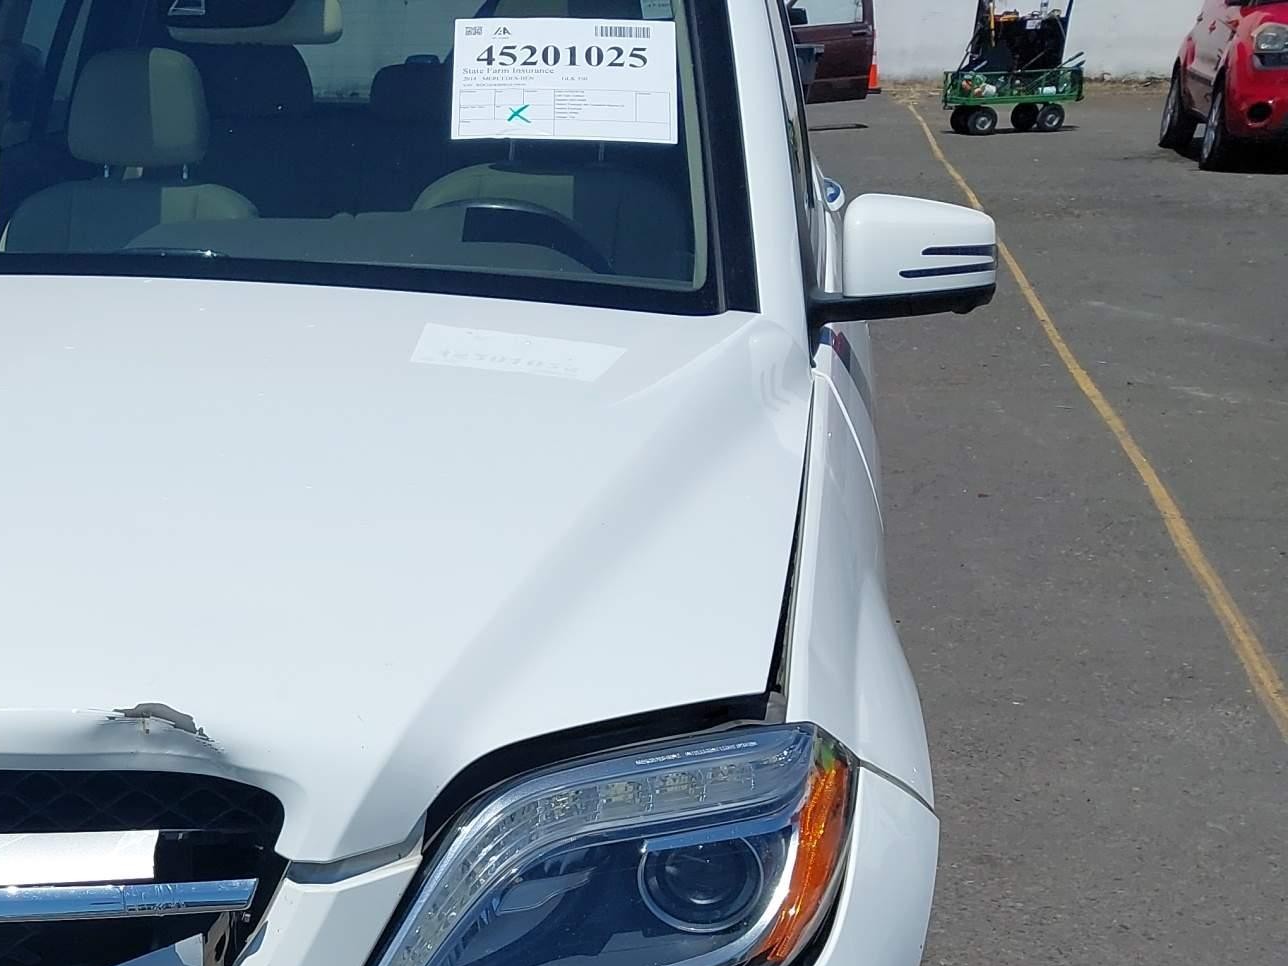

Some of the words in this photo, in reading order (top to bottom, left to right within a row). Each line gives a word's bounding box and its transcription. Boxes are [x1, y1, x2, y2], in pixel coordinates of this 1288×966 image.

[476, 44, 649, 68] 45201025
[462, 67, 484, 75] State
[486, 67, 510, 75] Farm
[512, 67, 555, 75] Insurance
